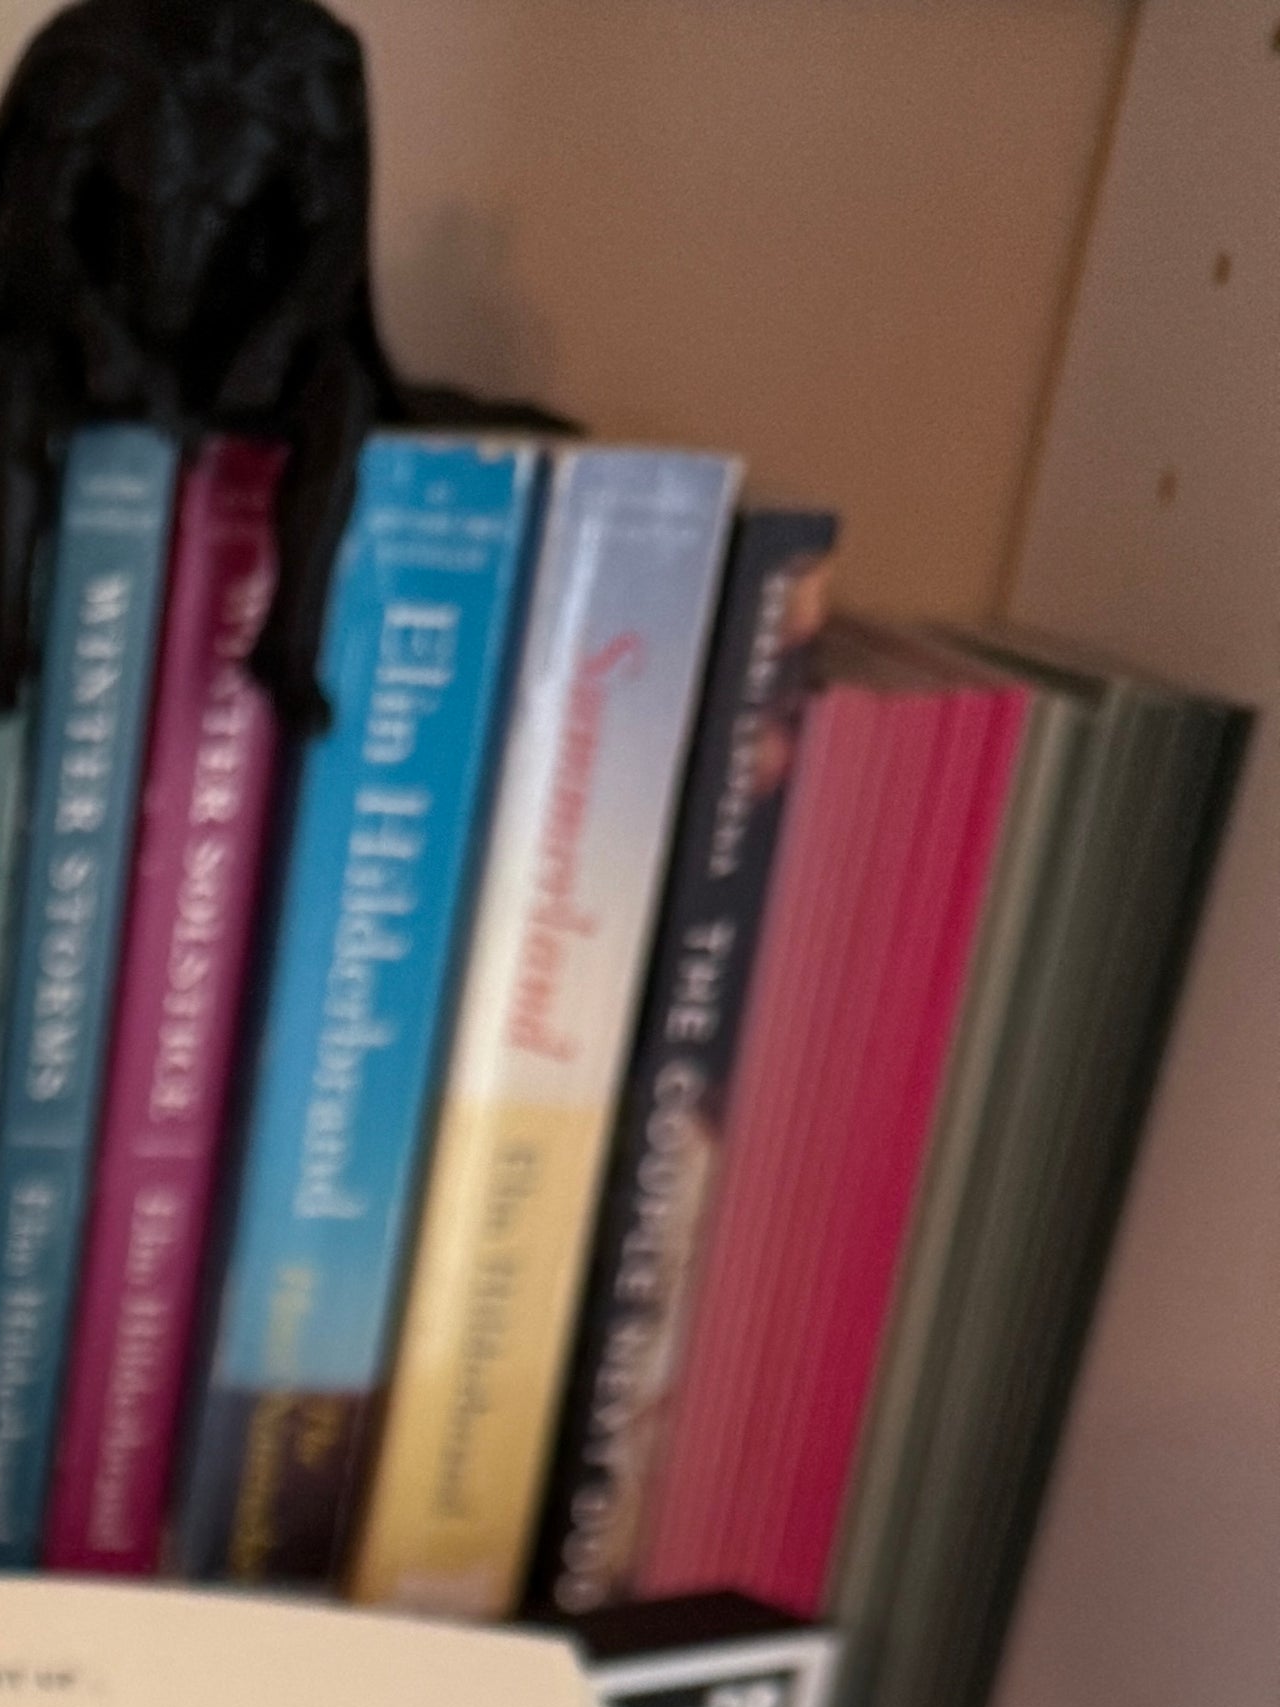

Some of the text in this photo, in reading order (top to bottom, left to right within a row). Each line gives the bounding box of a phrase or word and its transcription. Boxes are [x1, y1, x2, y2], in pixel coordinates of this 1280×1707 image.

[54, 567, 130, 838] WINTER
[362, 592, 458, 773] Elin
[505, 621, 652, 1069] Summerland
[23, 847, 95, 1106] STORMS
[289, 779, 428, 1229] Hilderbrand
[664, 912, 734, 1053] THE
[612, 1056, 707, 1311] COUPLE
